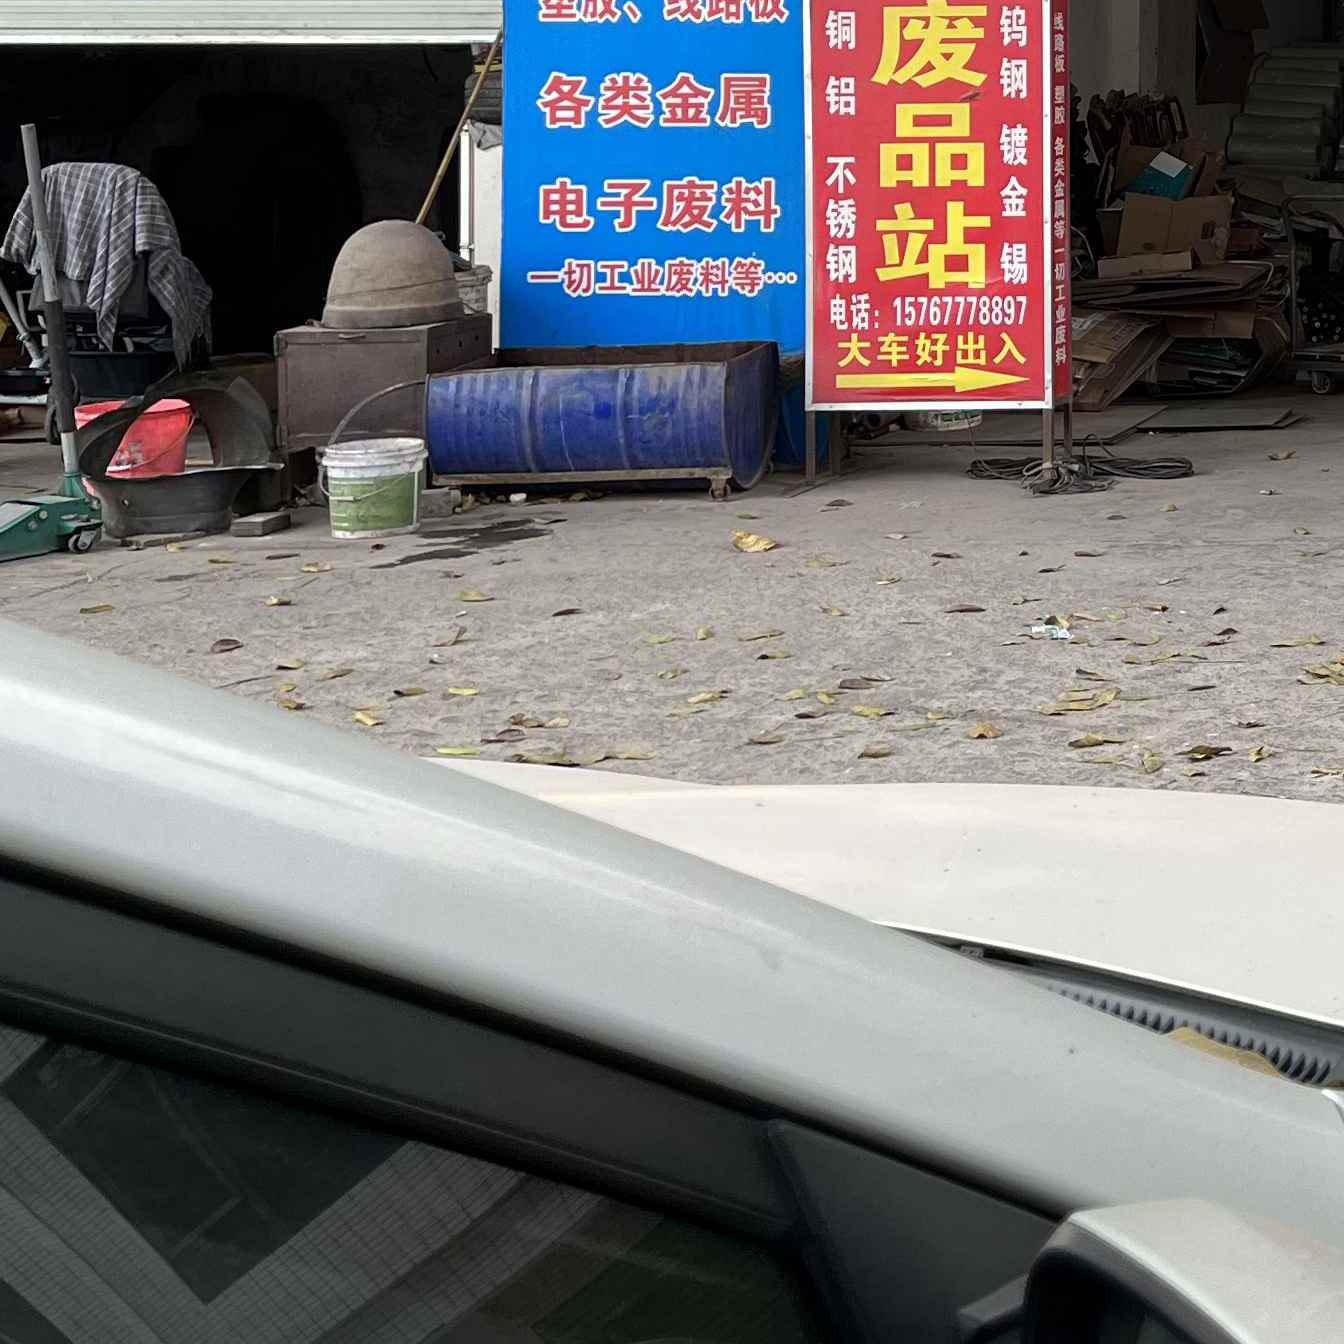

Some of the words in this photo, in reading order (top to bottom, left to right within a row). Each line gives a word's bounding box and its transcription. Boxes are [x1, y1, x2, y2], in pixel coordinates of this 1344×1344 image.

[825, 9, 857, 50] 铜
[537, 72, 772, 128] 各类金属
[825, 76, 857, 117] 铝
[539, 176, 781, 233] 电子废料
[825, 155, 857, 285] 不锈钢
[999, 242, 1029, 286] 锡
[838, 332, 1027, 368] 大车好出入
